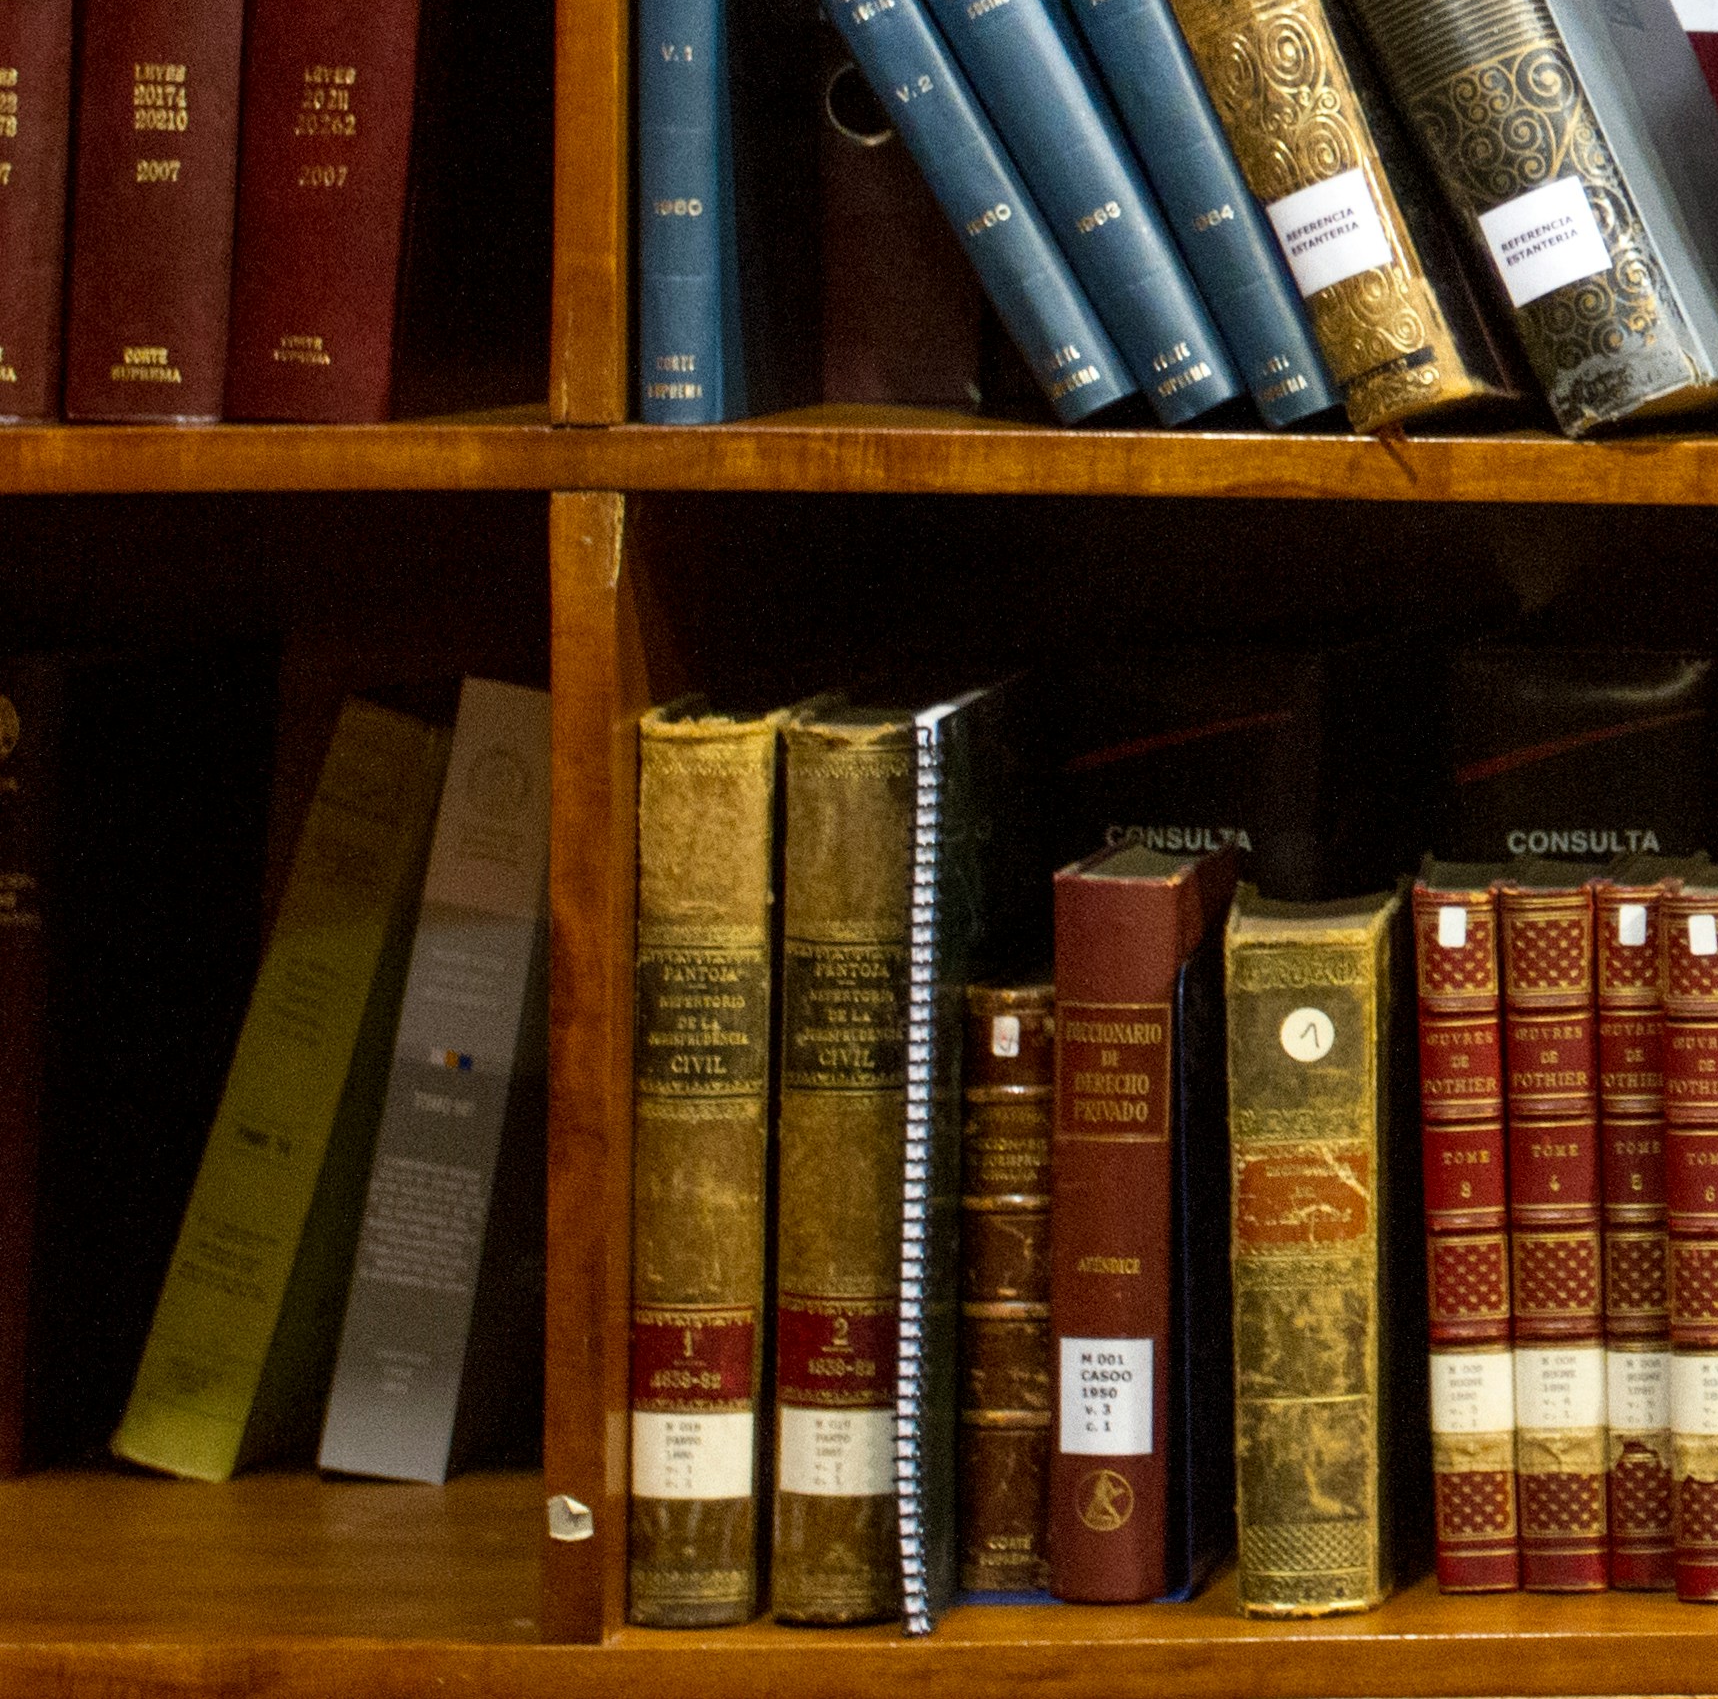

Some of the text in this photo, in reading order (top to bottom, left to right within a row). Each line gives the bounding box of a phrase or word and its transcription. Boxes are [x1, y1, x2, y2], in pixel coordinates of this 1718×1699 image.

[1285, 207, 1355, 243] REFERENCIA
[1500, 213, 1575, 252] REFERENCIA
[1290, 220, 1361, 258] ESTANTERIA
[1506, 227, 1579, 267] ESTANTERIA
[1508, 829, 1660, 854] CONSULTA
[1065, 1021, 1162, 1045] DICCIONARIO
[671, 1056, 726, 1075] CIVIL
[1074, 1074, 1150, 1095] DERECHO
[1072, 1100, 1150, 1121] PRIVADO
